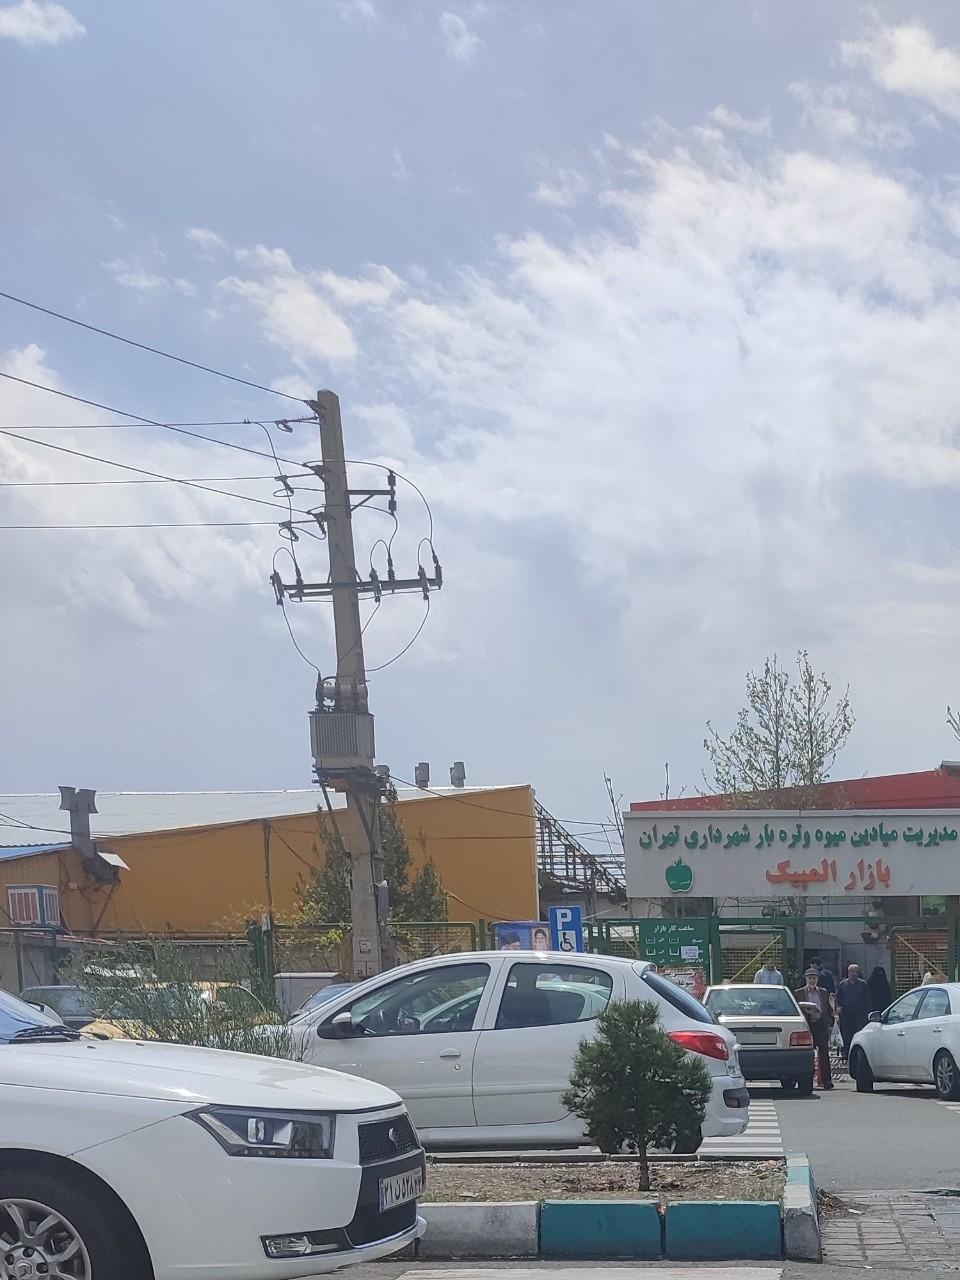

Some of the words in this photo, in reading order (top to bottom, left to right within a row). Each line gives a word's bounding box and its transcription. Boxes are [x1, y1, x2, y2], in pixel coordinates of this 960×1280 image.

[639, 823, 680, 849] تهران
[684, 823, 750, 849] شهرداری
[815, 828, 846, 849] میوه
[850, 822, 898, 848] میادین
[902, 825, 958, 848] مدیریت
[766, 857, 837, 891] المپیک
[844, 857, 891, 890] بازار
[556, 909, 572, 930] P
